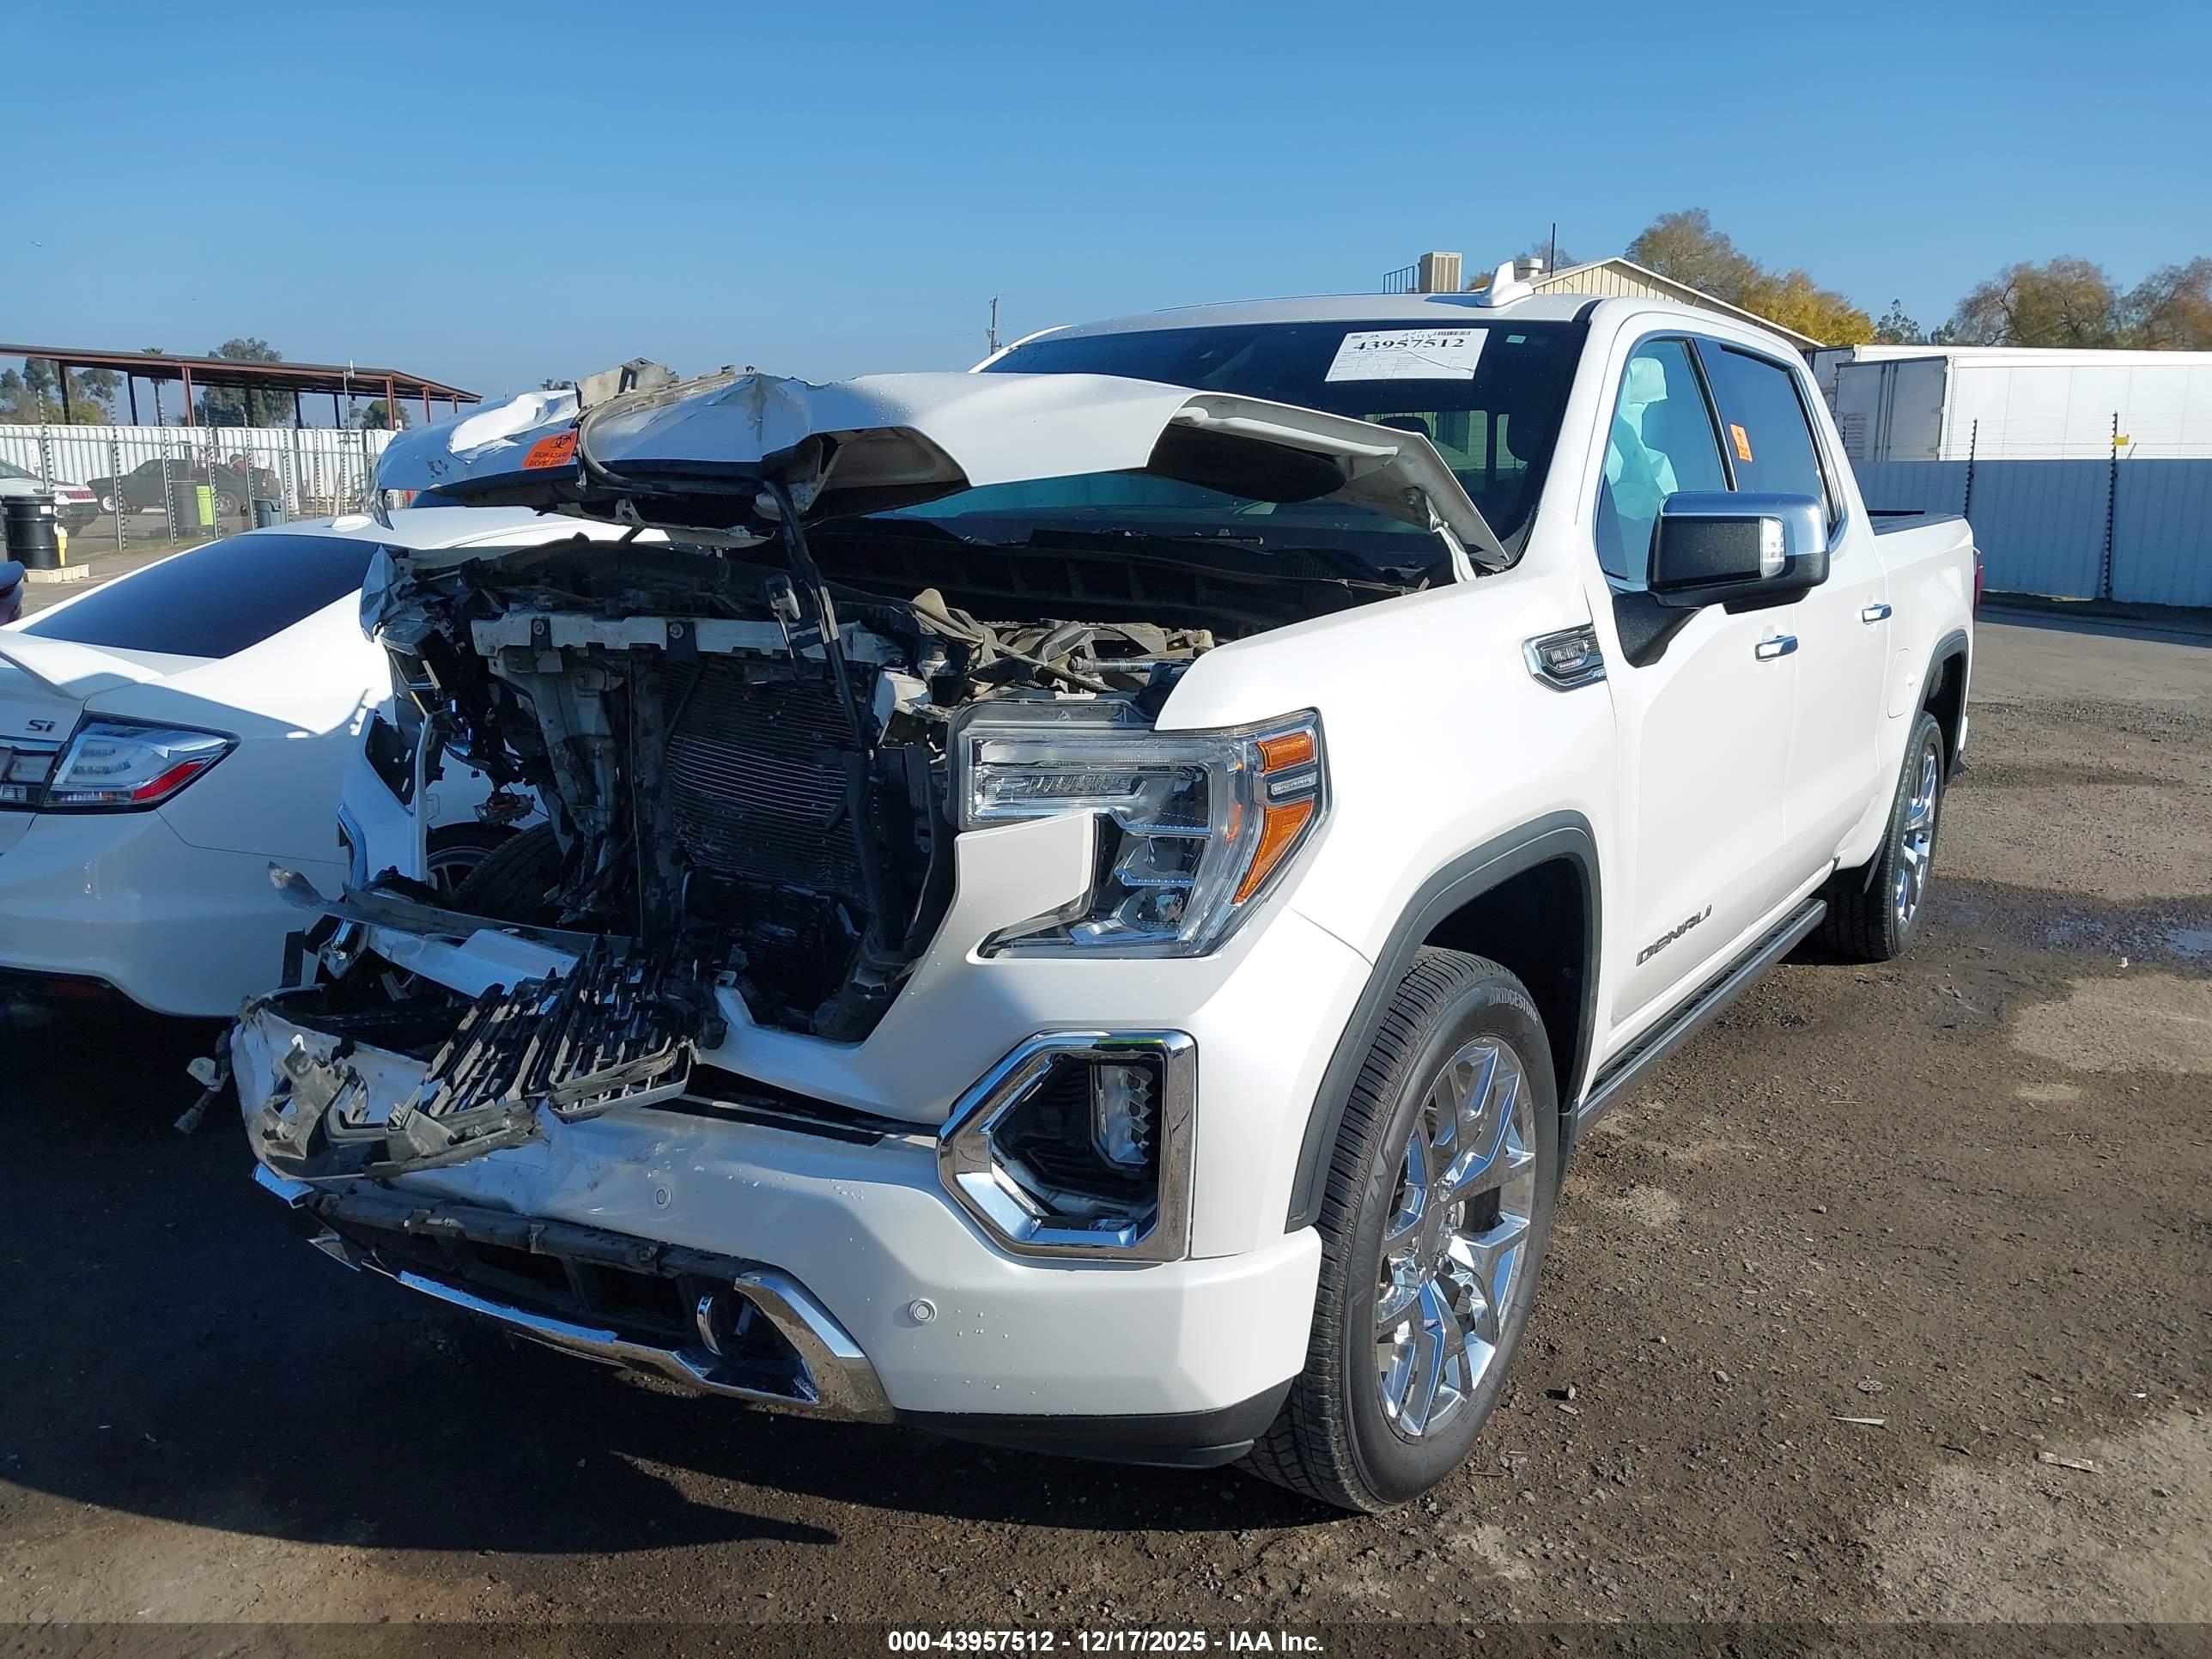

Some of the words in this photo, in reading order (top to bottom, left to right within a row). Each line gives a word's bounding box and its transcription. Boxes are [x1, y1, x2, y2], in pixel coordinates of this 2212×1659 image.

[1353, 338, 1465, 350] 43957512
[25, 719, 56, 732] Si
[1636, 903, 1712, 968] DENALI
[1488, 986, 1539, 1026] BRIDGESTONE
